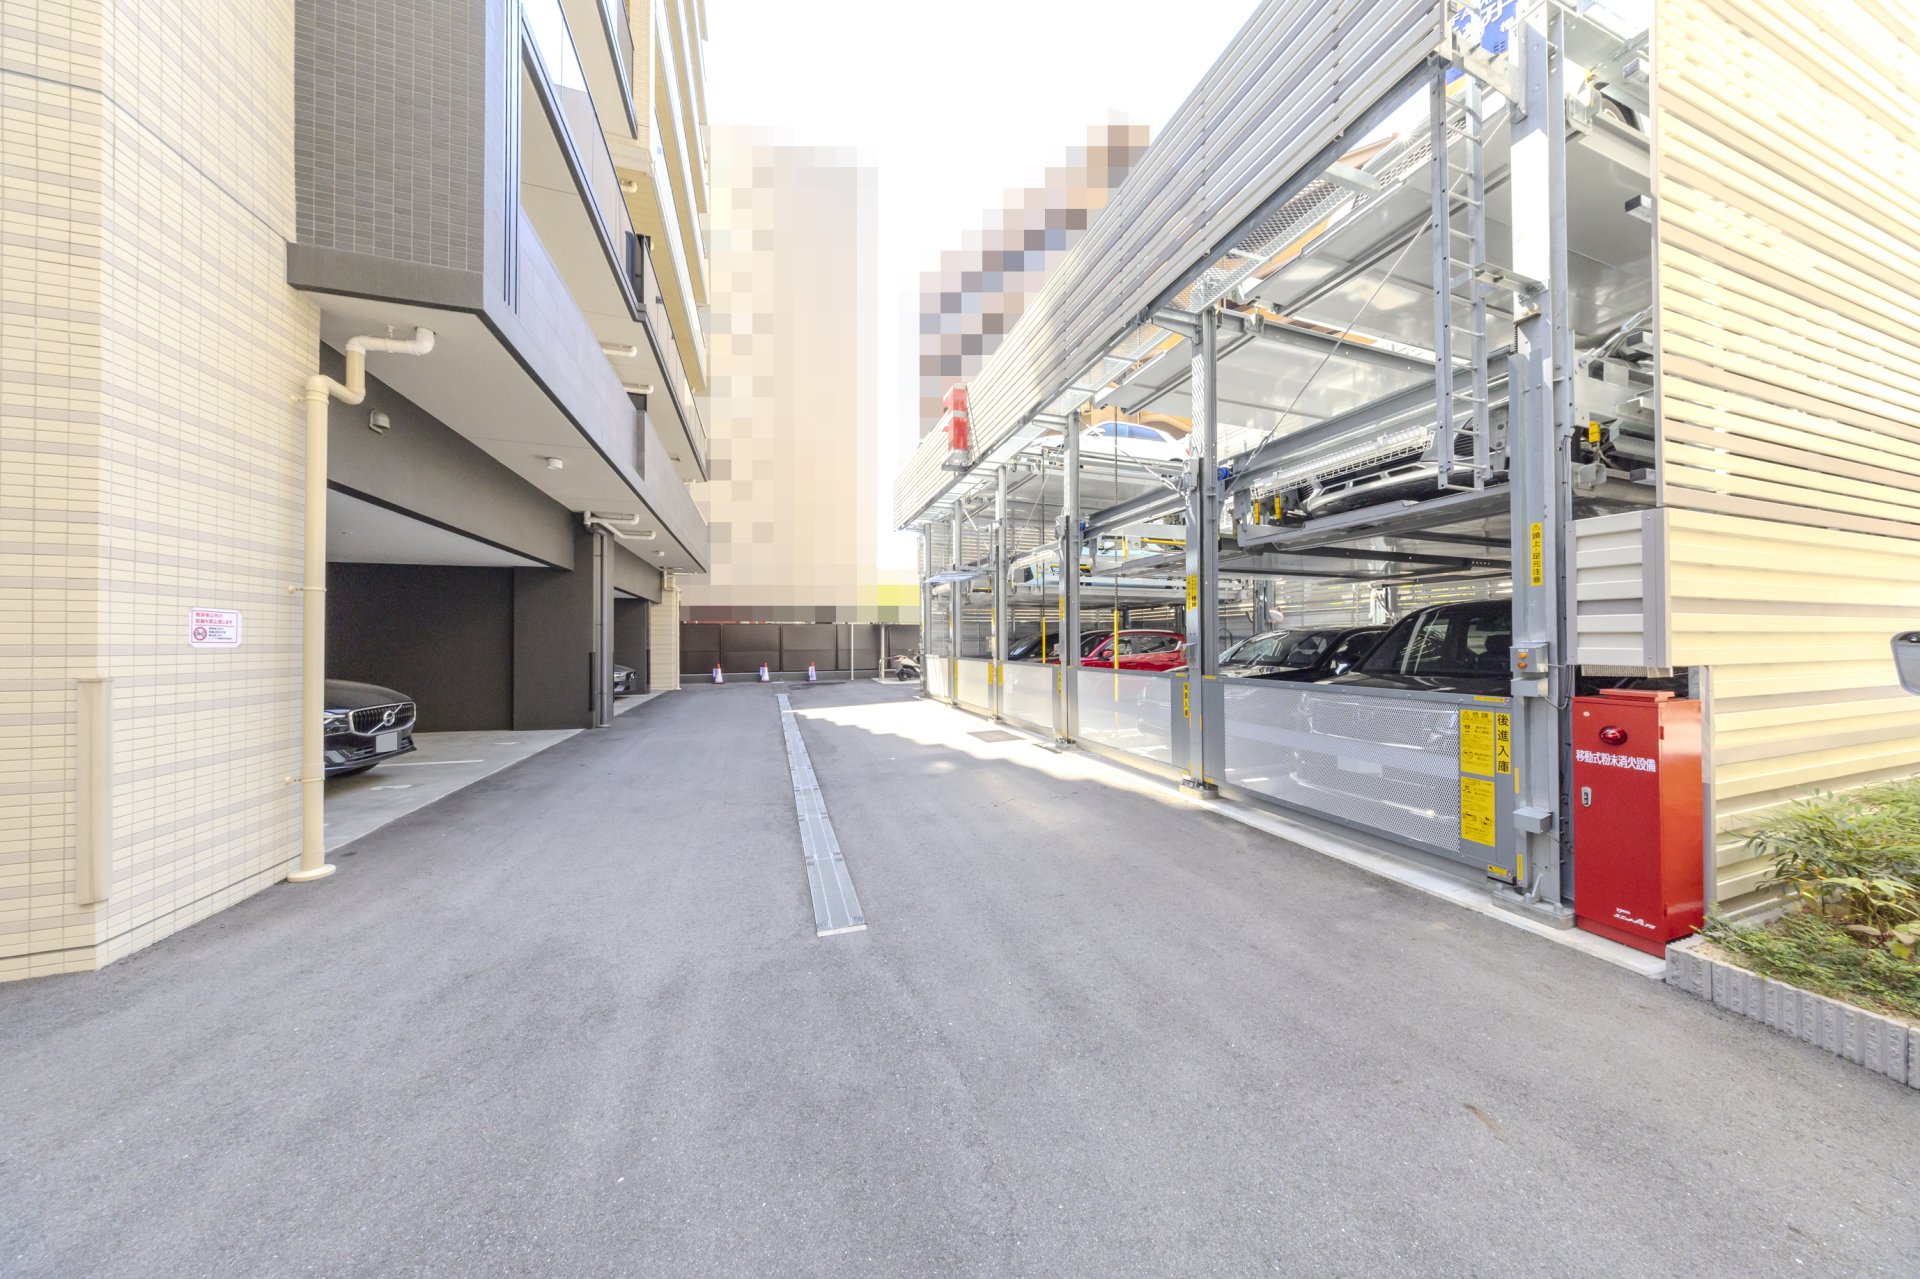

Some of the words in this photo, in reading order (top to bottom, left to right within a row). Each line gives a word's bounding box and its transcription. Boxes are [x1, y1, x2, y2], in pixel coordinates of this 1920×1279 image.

[1497, 714, 1510, 772] 後進入庫
[1576, 749, 1656, 772] 移動式粉末消火設備
